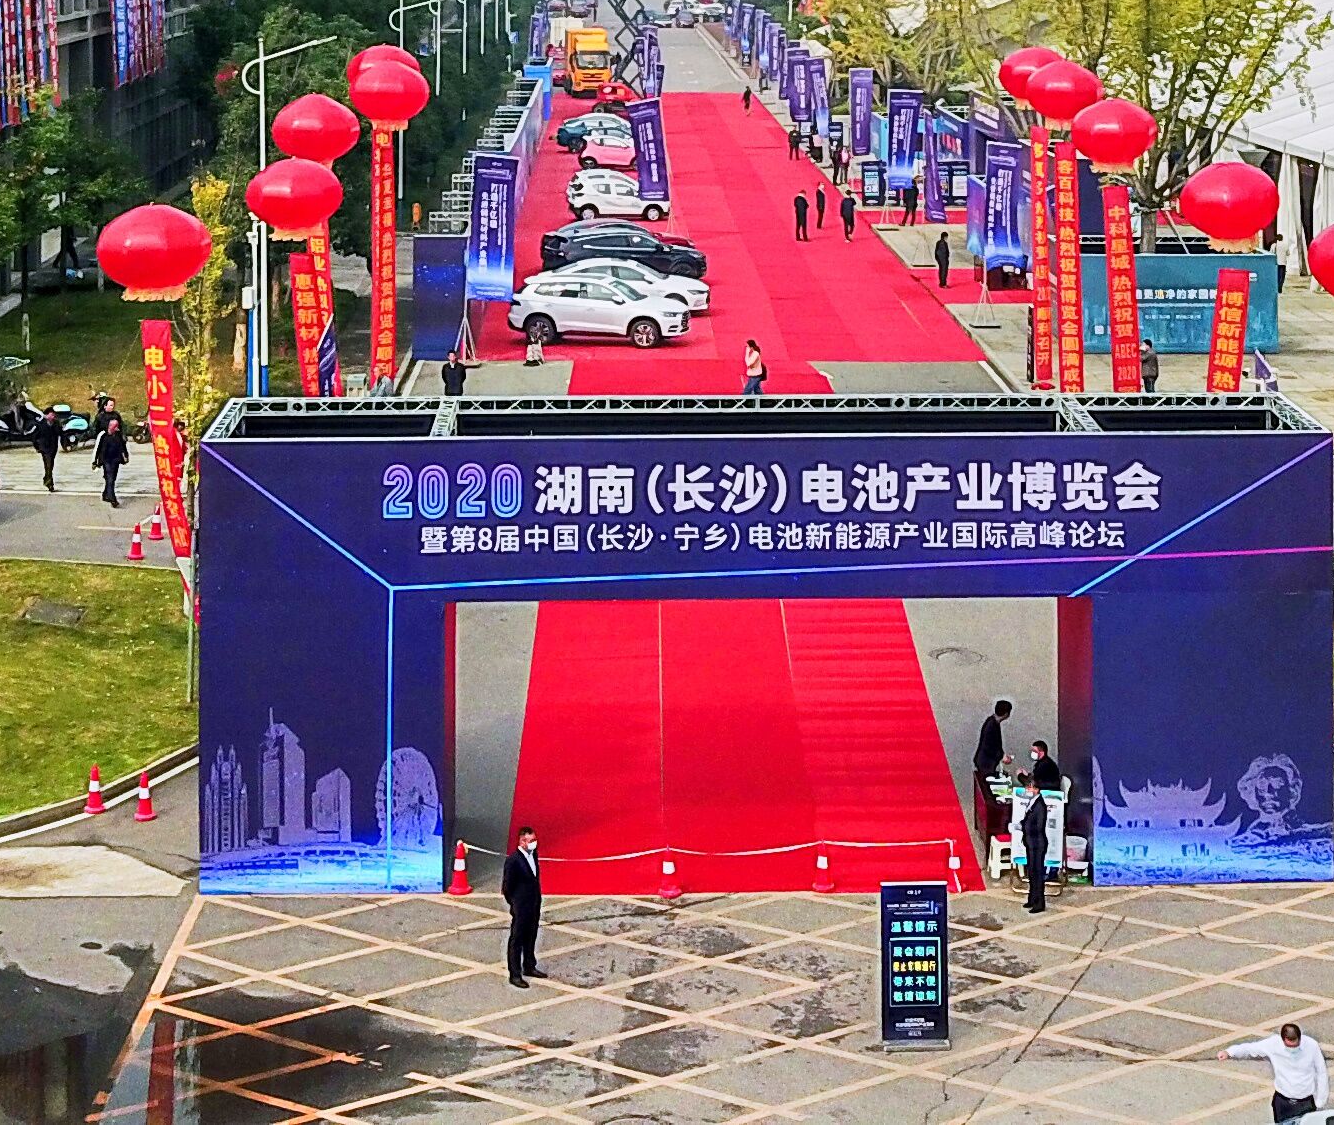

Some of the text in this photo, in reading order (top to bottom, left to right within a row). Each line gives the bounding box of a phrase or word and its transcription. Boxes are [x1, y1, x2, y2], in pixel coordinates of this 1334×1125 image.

[1056, 159, 1076, 222] 容百科技
[294, 272, 321, 342] 惠强新材
[1107, 204, 1138, 381] 中科星城 热烈祝贺 ABEC 2020
[1213, 290, 1245, 369] 博信新能源
[144, 344, 169, 427] 电小二
[380, 460, 1163, 520] 2020 湖南（长沙）电池产业博览会
[420, 521, 1127, 557] 暨第8届中国（长沙·宁乡）电池新能源产业国际高峰论坛
